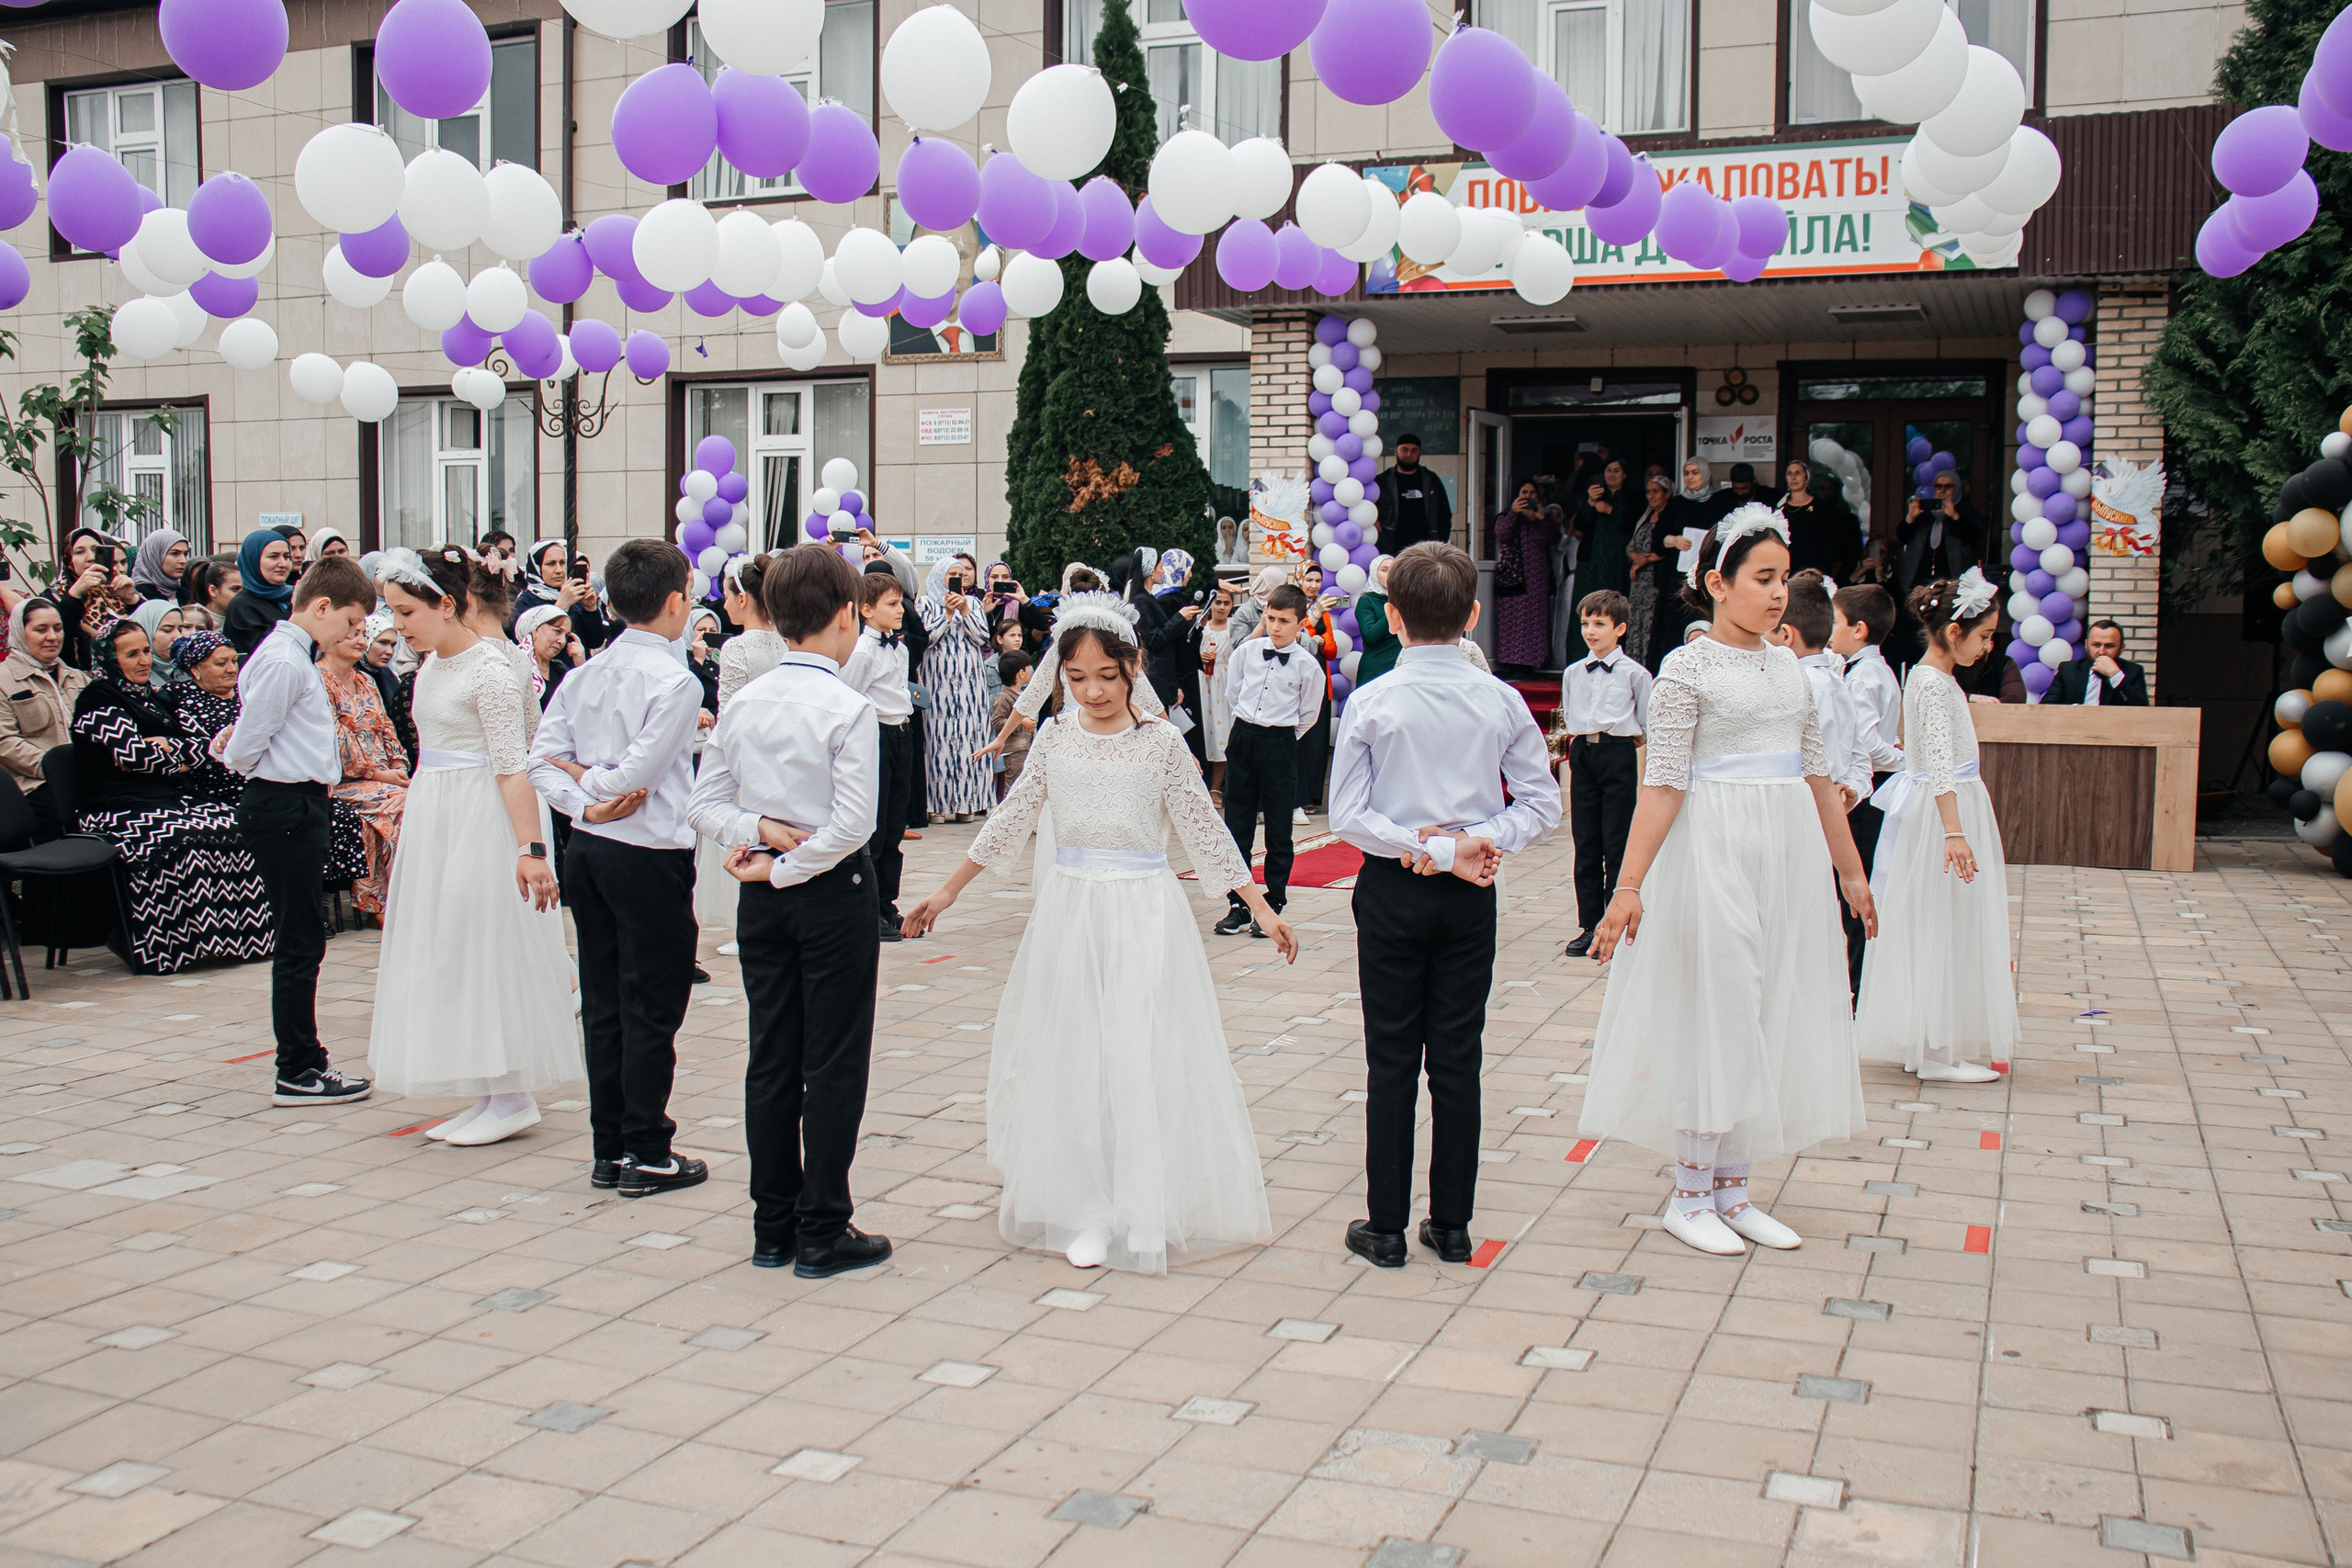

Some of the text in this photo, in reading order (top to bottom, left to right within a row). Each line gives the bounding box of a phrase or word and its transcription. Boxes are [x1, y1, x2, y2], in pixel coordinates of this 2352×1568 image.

[1657, 155, 1889, 201] ЖАЛОВАТЬ!
[1698, 435, 1773, 445] ТОЧКА РОСТА
[261, 514, 300, 525] ПОЖАРНЫЙ ЩИТ
